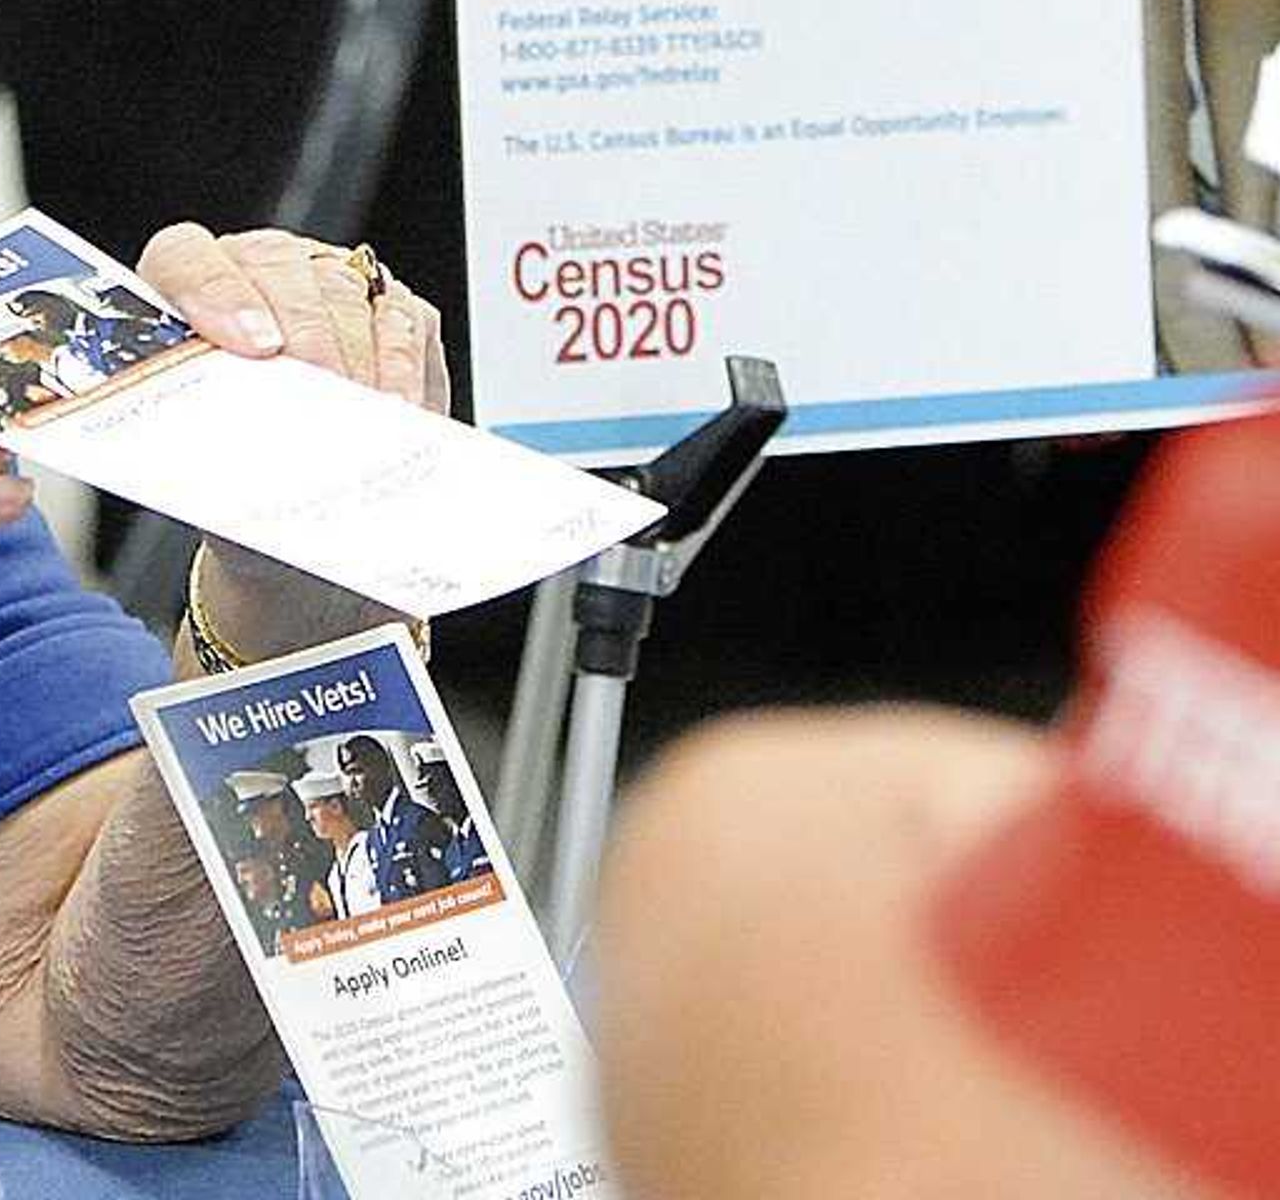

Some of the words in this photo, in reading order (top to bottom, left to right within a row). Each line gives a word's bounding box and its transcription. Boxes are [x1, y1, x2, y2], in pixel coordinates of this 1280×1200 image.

[503, 134, 539, 156] The
[549, 221, 638, 250] United
[642, 218, 729, 245] States
[514, 241, 725, 302] Census
[554, 298, 696, 363] 2020
[196, 703, 250, 747] We
[247, 693, 305, 734] Hire
[305, 670, 377, 719] Vets!
[333, 963, 390, 998] Apply
[391, 936, 469, 980] Online!
